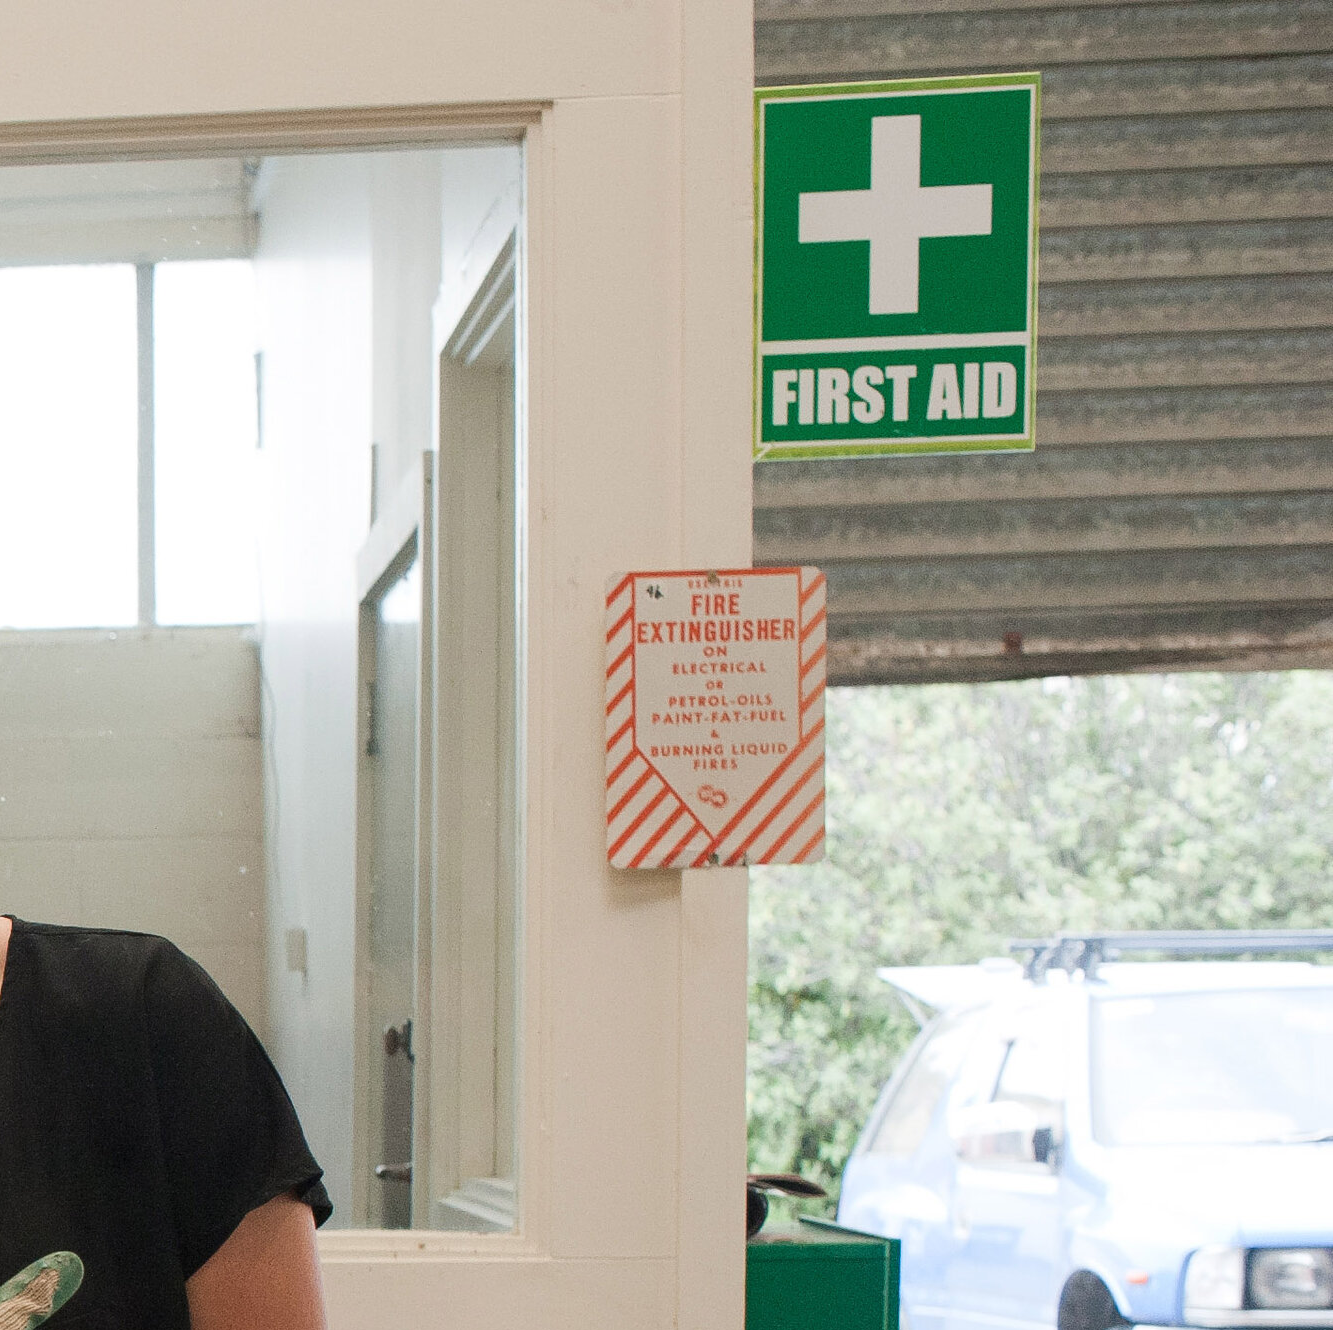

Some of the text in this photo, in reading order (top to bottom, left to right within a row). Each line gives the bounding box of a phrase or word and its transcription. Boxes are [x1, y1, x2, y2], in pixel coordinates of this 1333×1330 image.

[771, 361, 1018, 427] FIRST AID
[691, 594, 740, 616] FIRE
[637, 618, 796, 644] EXTINGUISHER
[703, 646, 728, 657] ON
[672, 662, 767, 675] ELECTRICAL
[706, 680, 724, 690] OR
[668, 694, 774, 707] PETROL-OILS
[651, 711, 787, 724] PAINT-FAT-FUEL
[710, 729, 720, 739] &
[650, 743, 788, 757] BURNING LIQUID
[693, 759, 739, 770] FIRES
